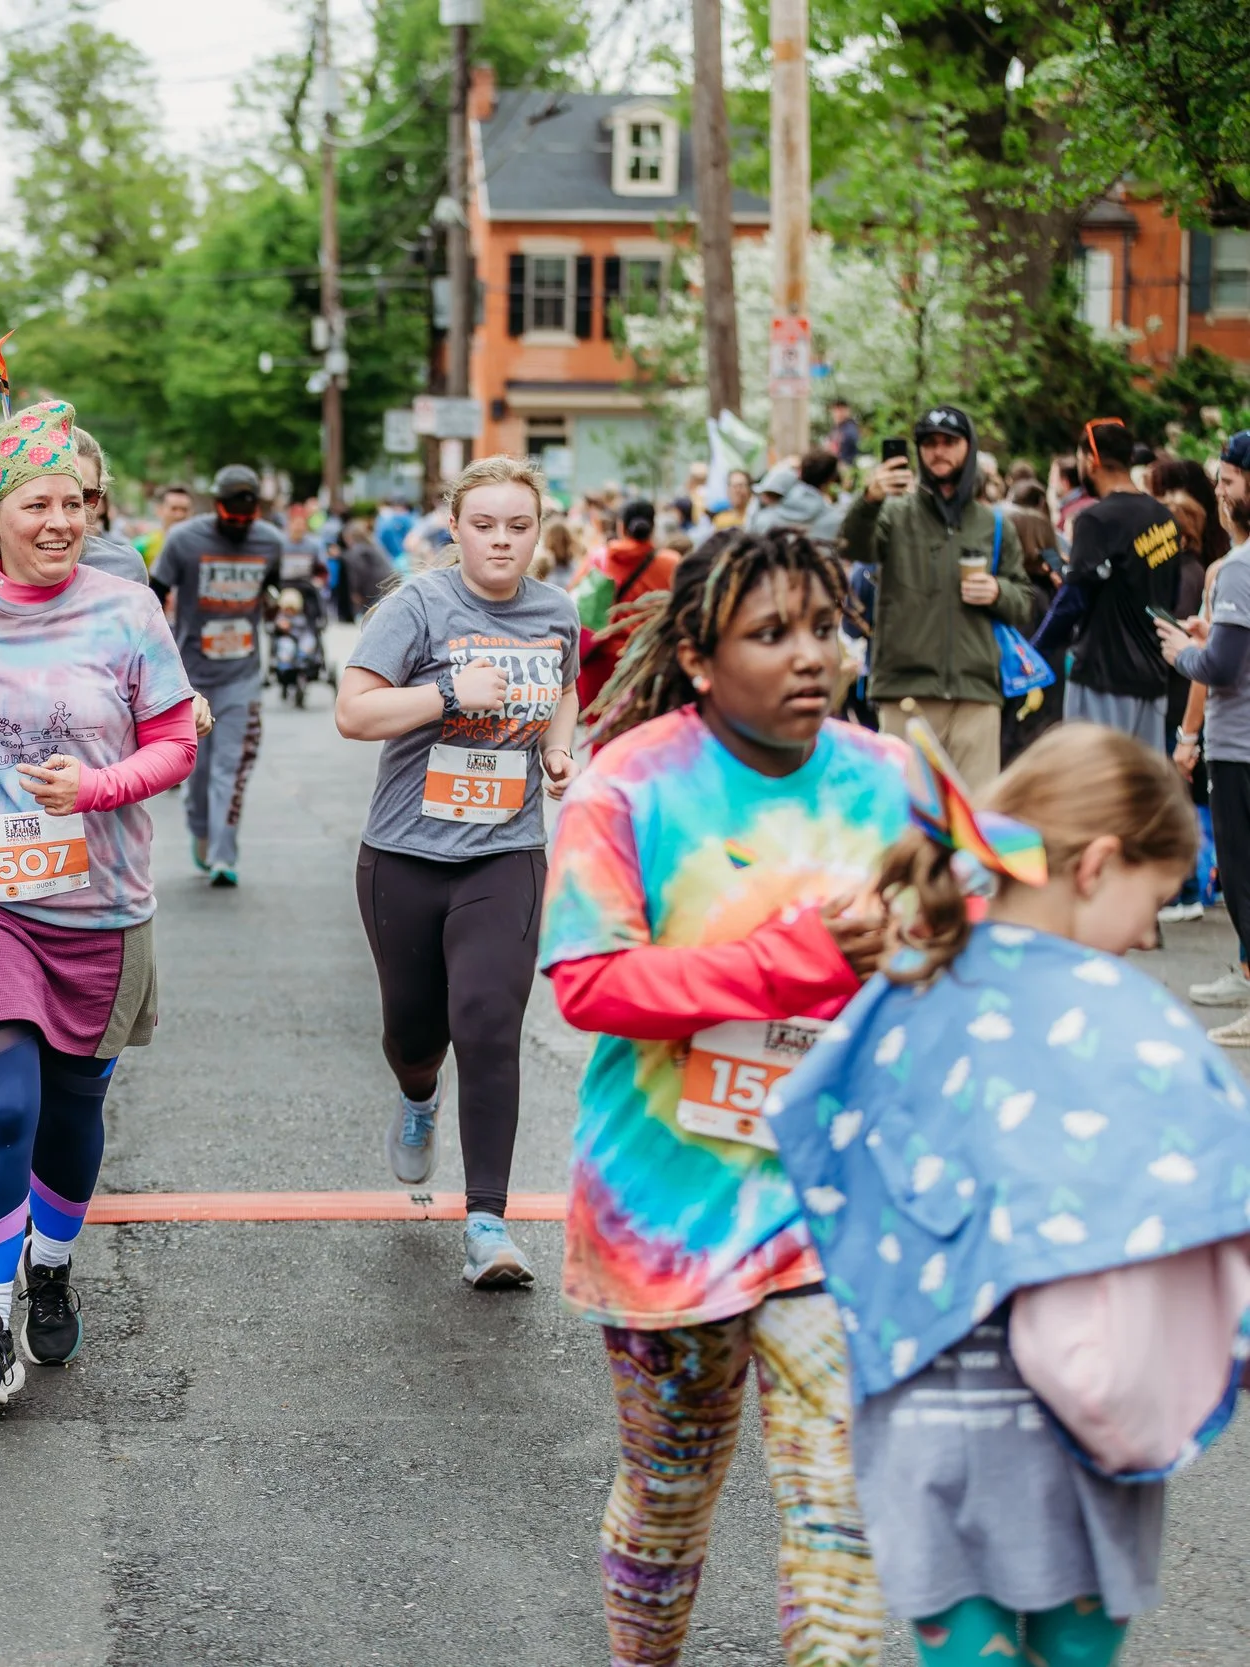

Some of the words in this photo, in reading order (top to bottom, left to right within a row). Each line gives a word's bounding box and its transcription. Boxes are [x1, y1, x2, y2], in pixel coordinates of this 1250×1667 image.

[472, 634, 511, 648] Years
[510, 684, 561, 702] ains
[450, 778, 502, 806] 531
